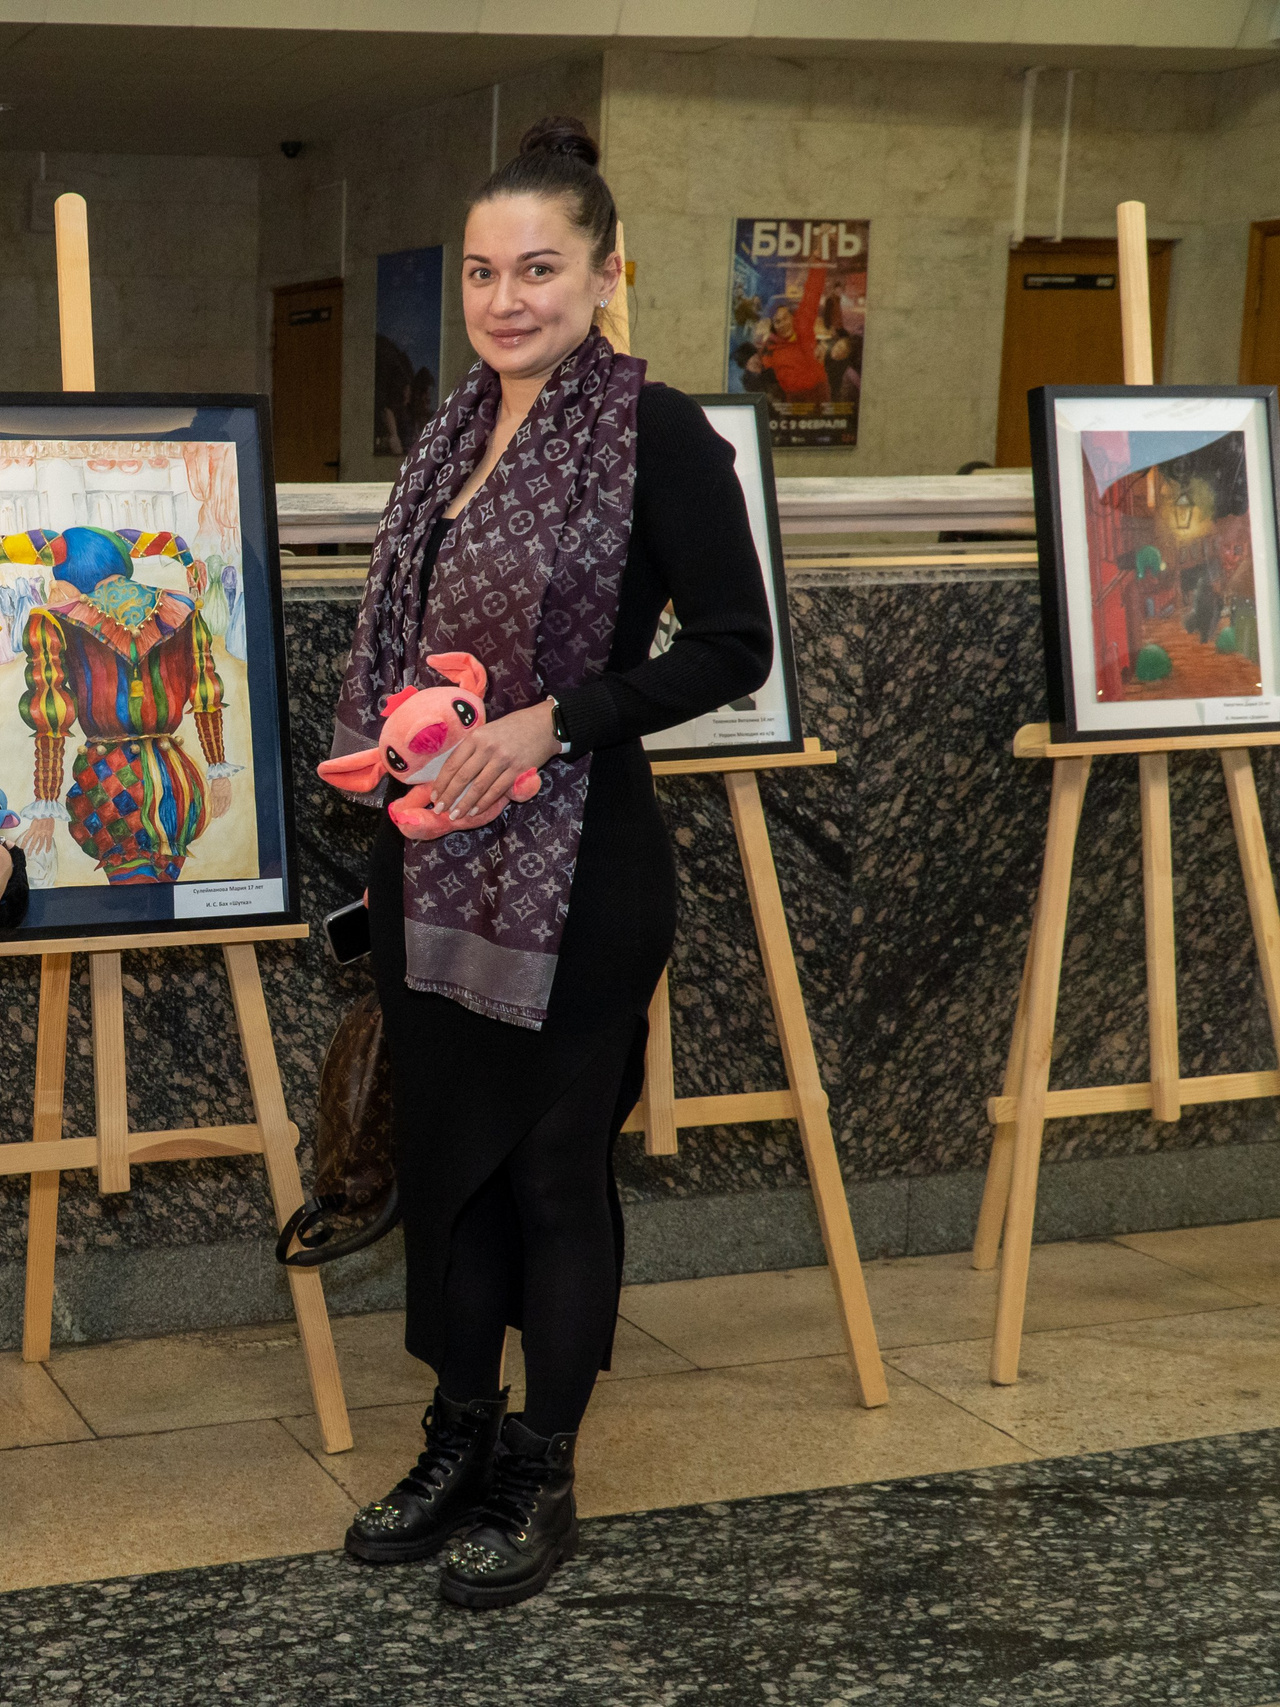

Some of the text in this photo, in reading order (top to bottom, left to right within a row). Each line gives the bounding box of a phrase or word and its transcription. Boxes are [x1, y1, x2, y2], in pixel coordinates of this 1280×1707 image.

[750, 221, 862, 260] БЫТЬ
[192, 887, 228, 895] Сулейманова
[229, 885, 247, 893] Мария
